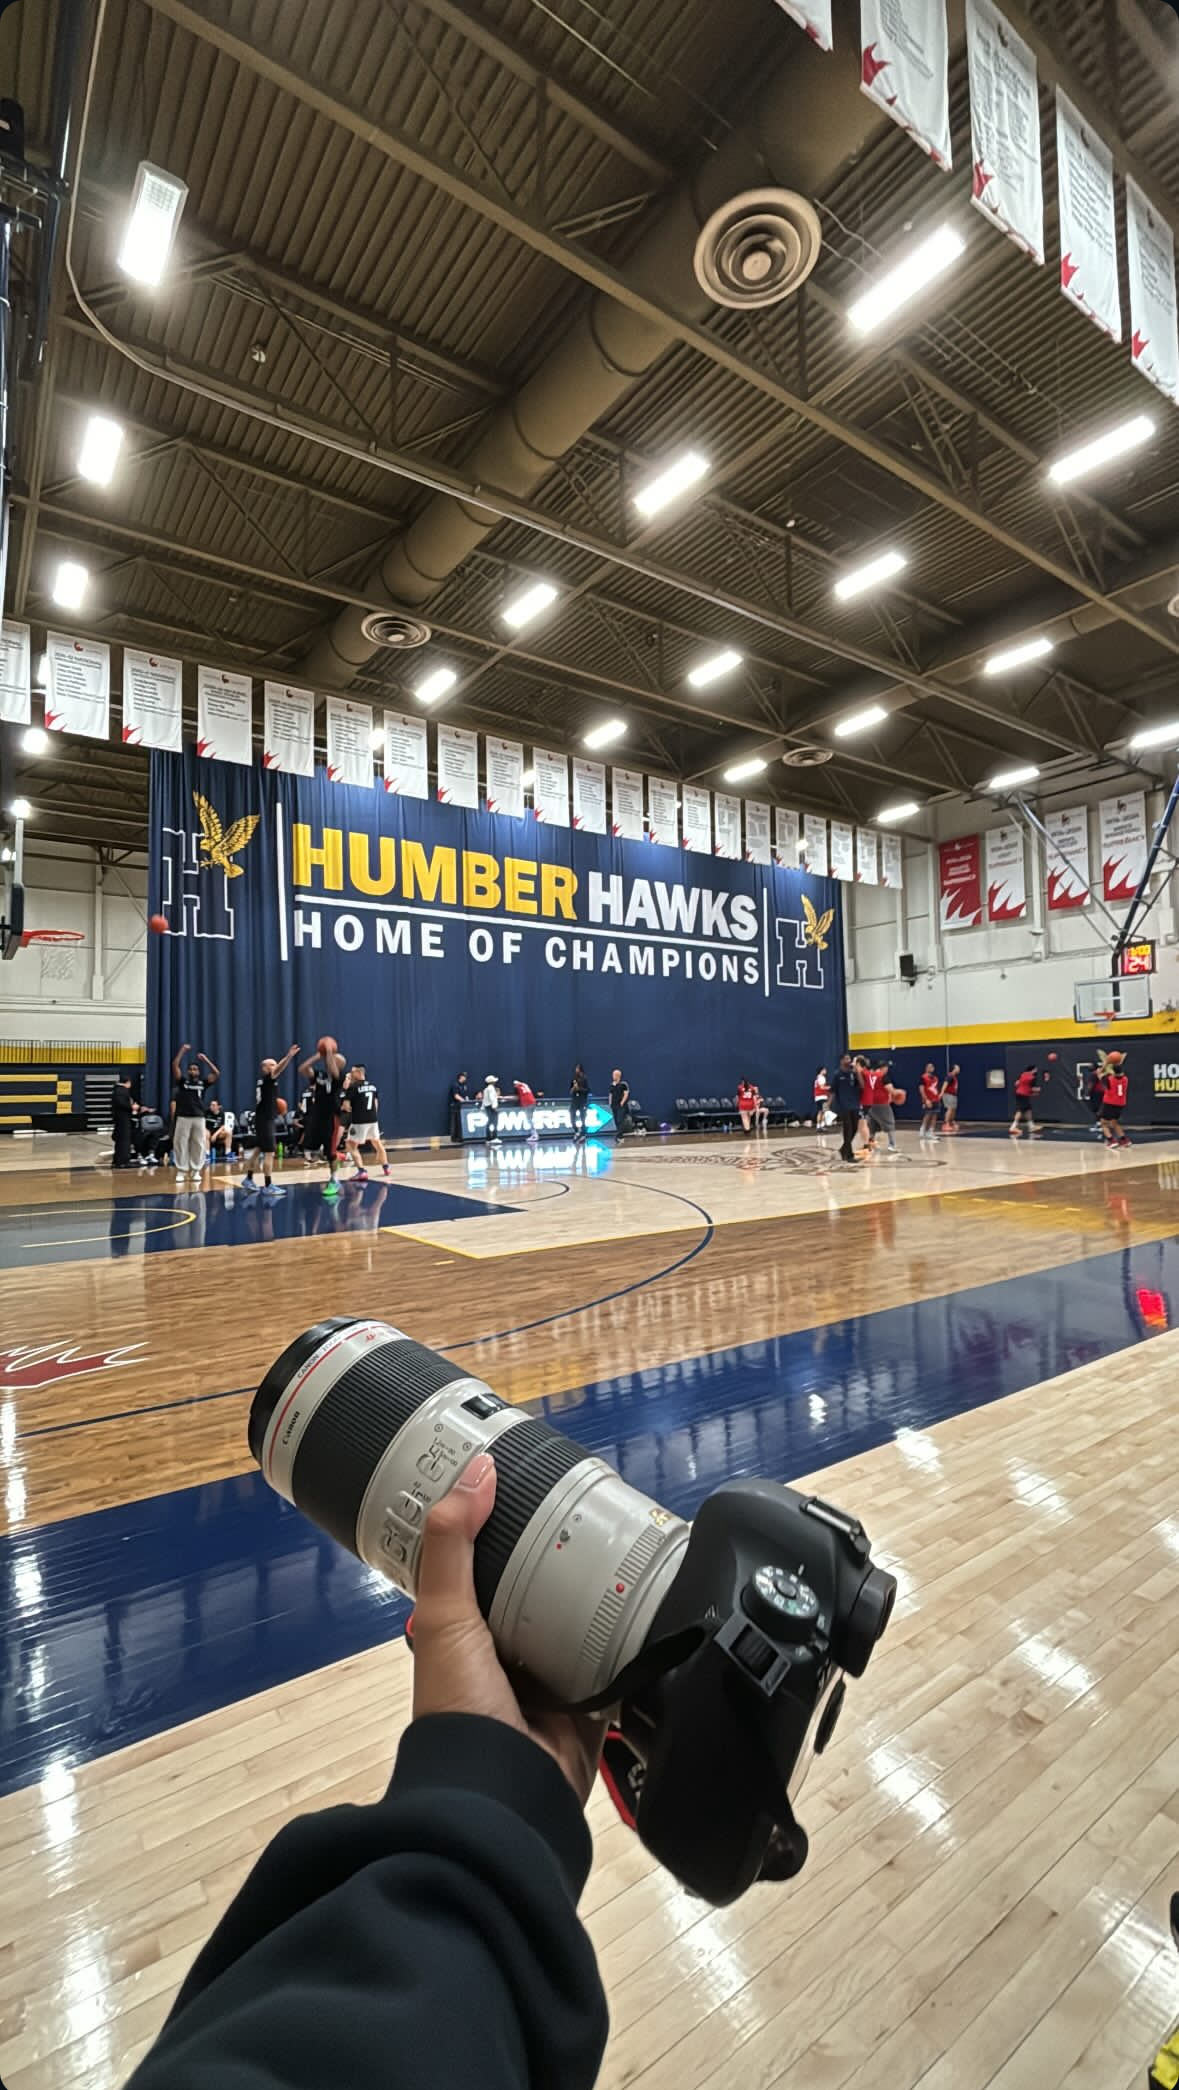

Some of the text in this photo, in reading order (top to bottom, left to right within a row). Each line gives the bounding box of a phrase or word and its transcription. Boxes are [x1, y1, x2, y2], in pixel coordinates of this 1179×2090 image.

[292, 823, 759, 942] HUMBER HAWKS
[293, 909, 760, 985] HOME OF CHAMPIONS
[1128, 955, 1150, 973] 24
[298, 1353, 320, 1379] CANON
[282, 1410, 300, 1445] Canon
